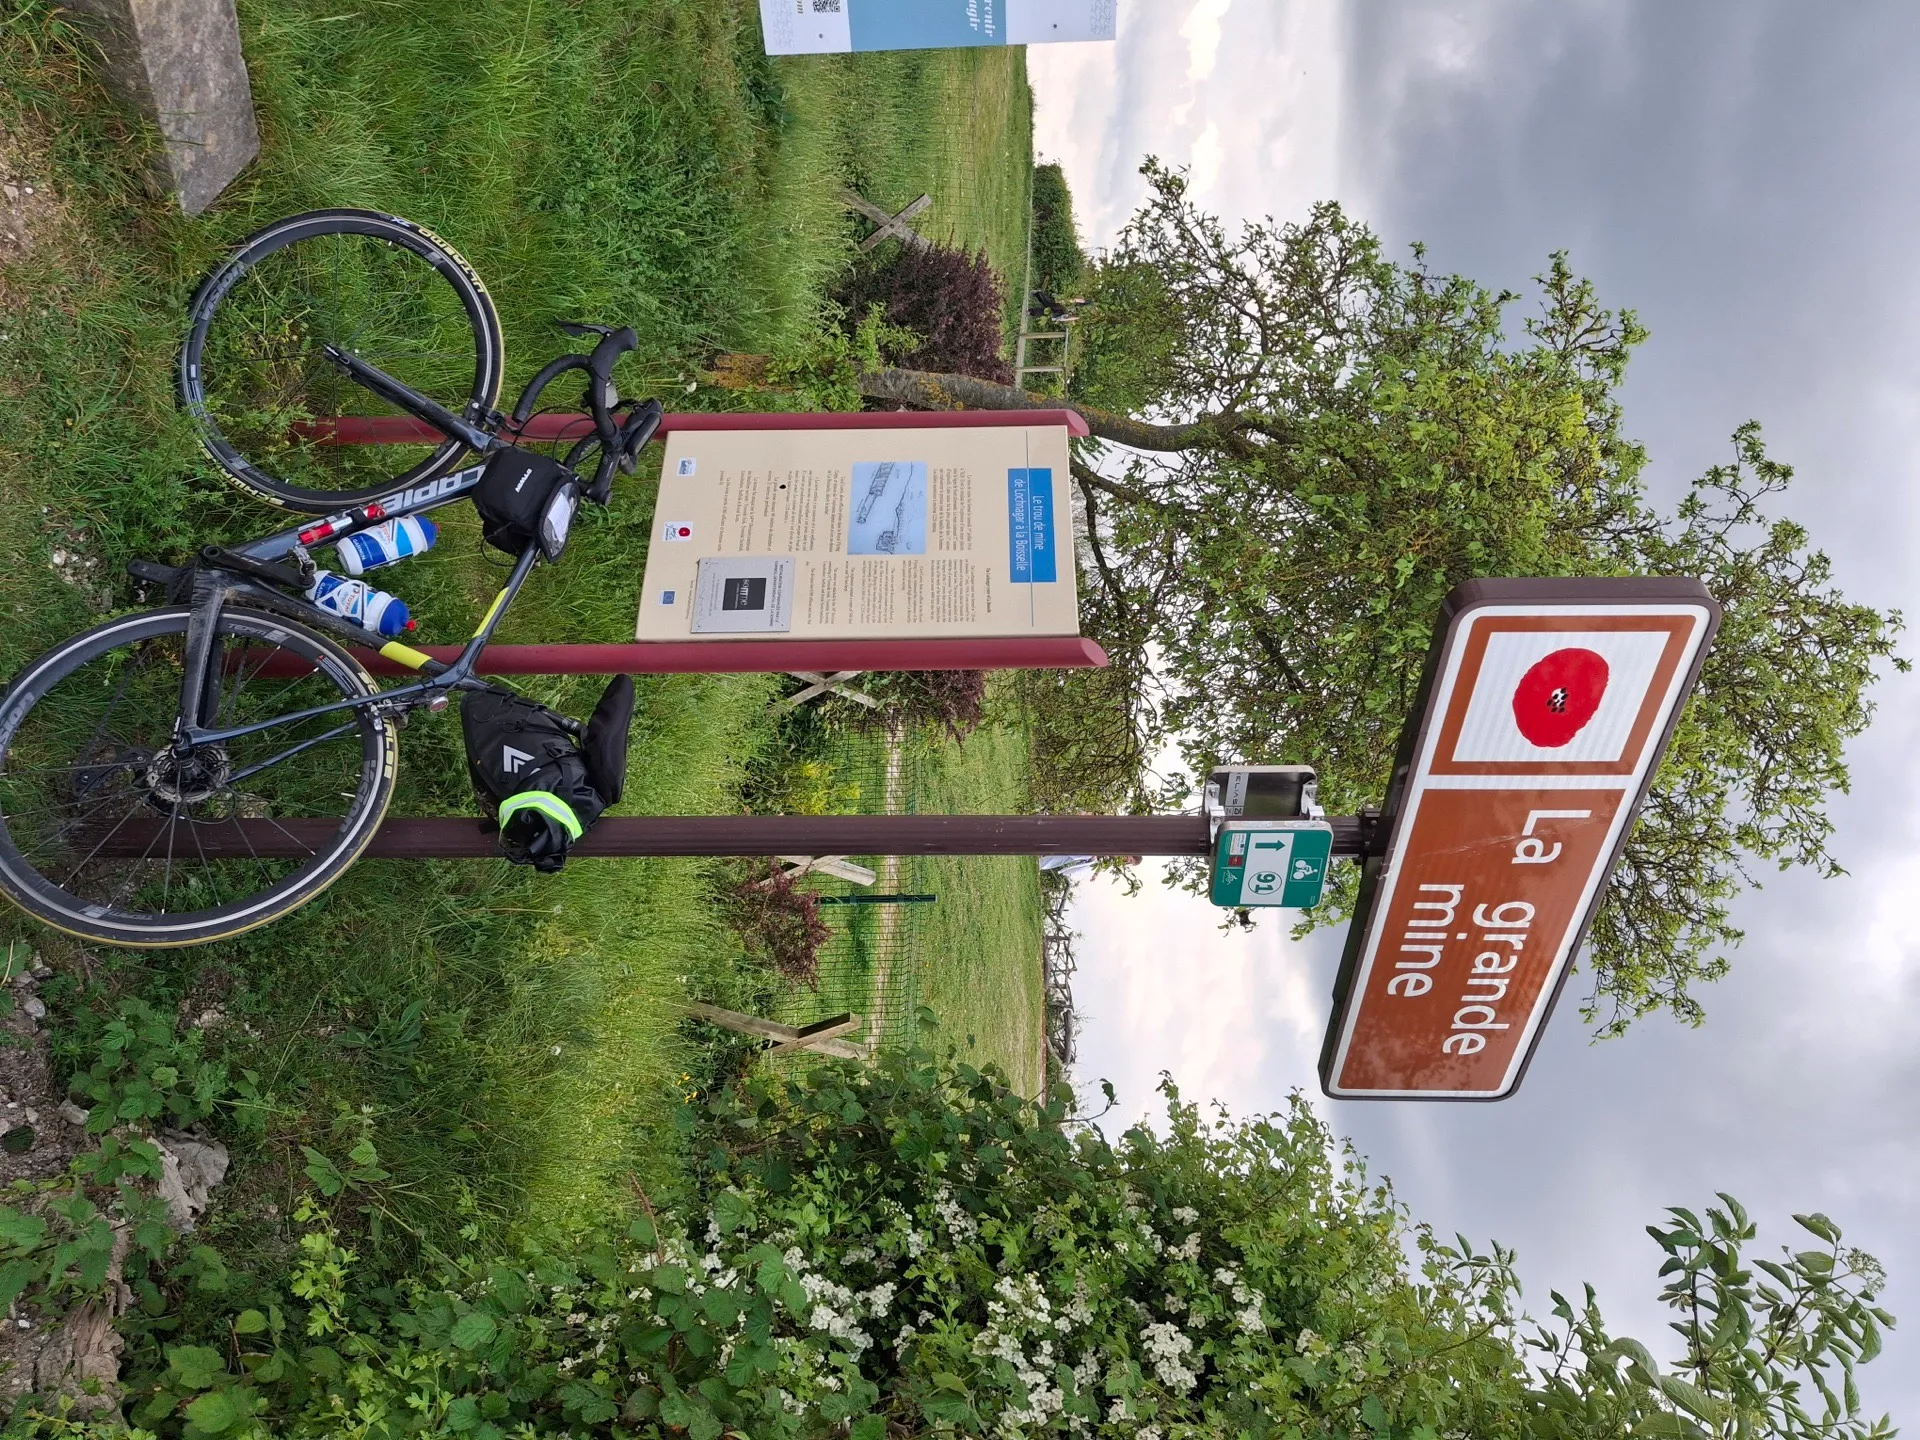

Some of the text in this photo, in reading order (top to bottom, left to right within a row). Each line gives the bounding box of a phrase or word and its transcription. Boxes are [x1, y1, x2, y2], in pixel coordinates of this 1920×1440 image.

[1014, 478, 1026, 488] de
[1012, 488, 1027, 524] Lochnagar
[1032, 495, 1046, 550] Le trou de mine
[1016, 540, 1028, 571] Boisselle
[1254, 873, 1276, 893] 91
[1387, 883, 1468, 998] mine
[1442, 809, 1592, 1055] La grande
